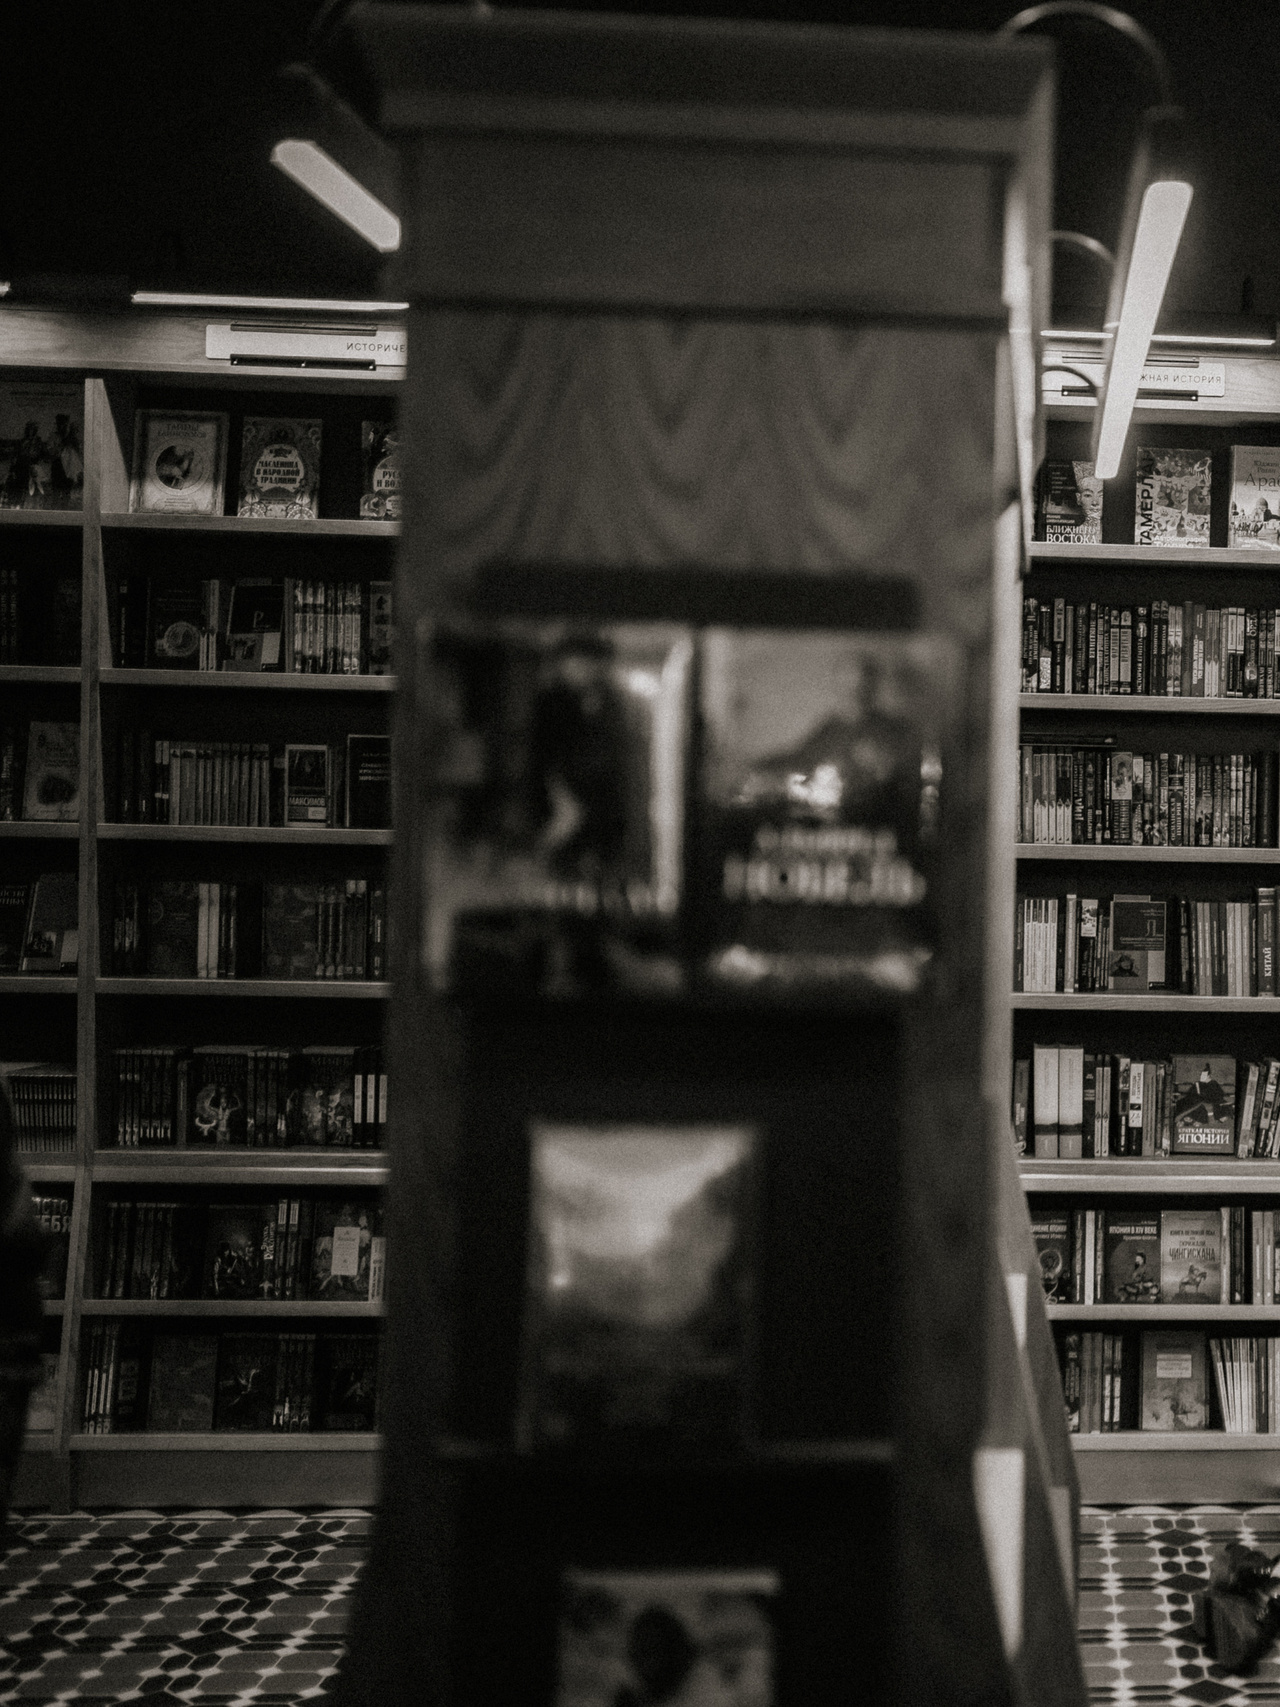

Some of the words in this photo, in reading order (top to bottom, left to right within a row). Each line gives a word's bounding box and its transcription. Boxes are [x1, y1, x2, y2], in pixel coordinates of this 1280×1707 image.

[346, 342, 406, 354] ИСТОРИЧЕ
[1172, 375, 1222, 384] ИСТОРИЯ
[1139, 451, 1155, 546] ТАМЕРЛАН
[1046, 525, 1097, 533] БЛИЖНЕГО
[1046, 533, 1097, 544] ВОСТОКА
[1263, 947, 1271, 976] КИТАЙ
[1177, 1133, 1230, 1145] ЯПОНИИ
